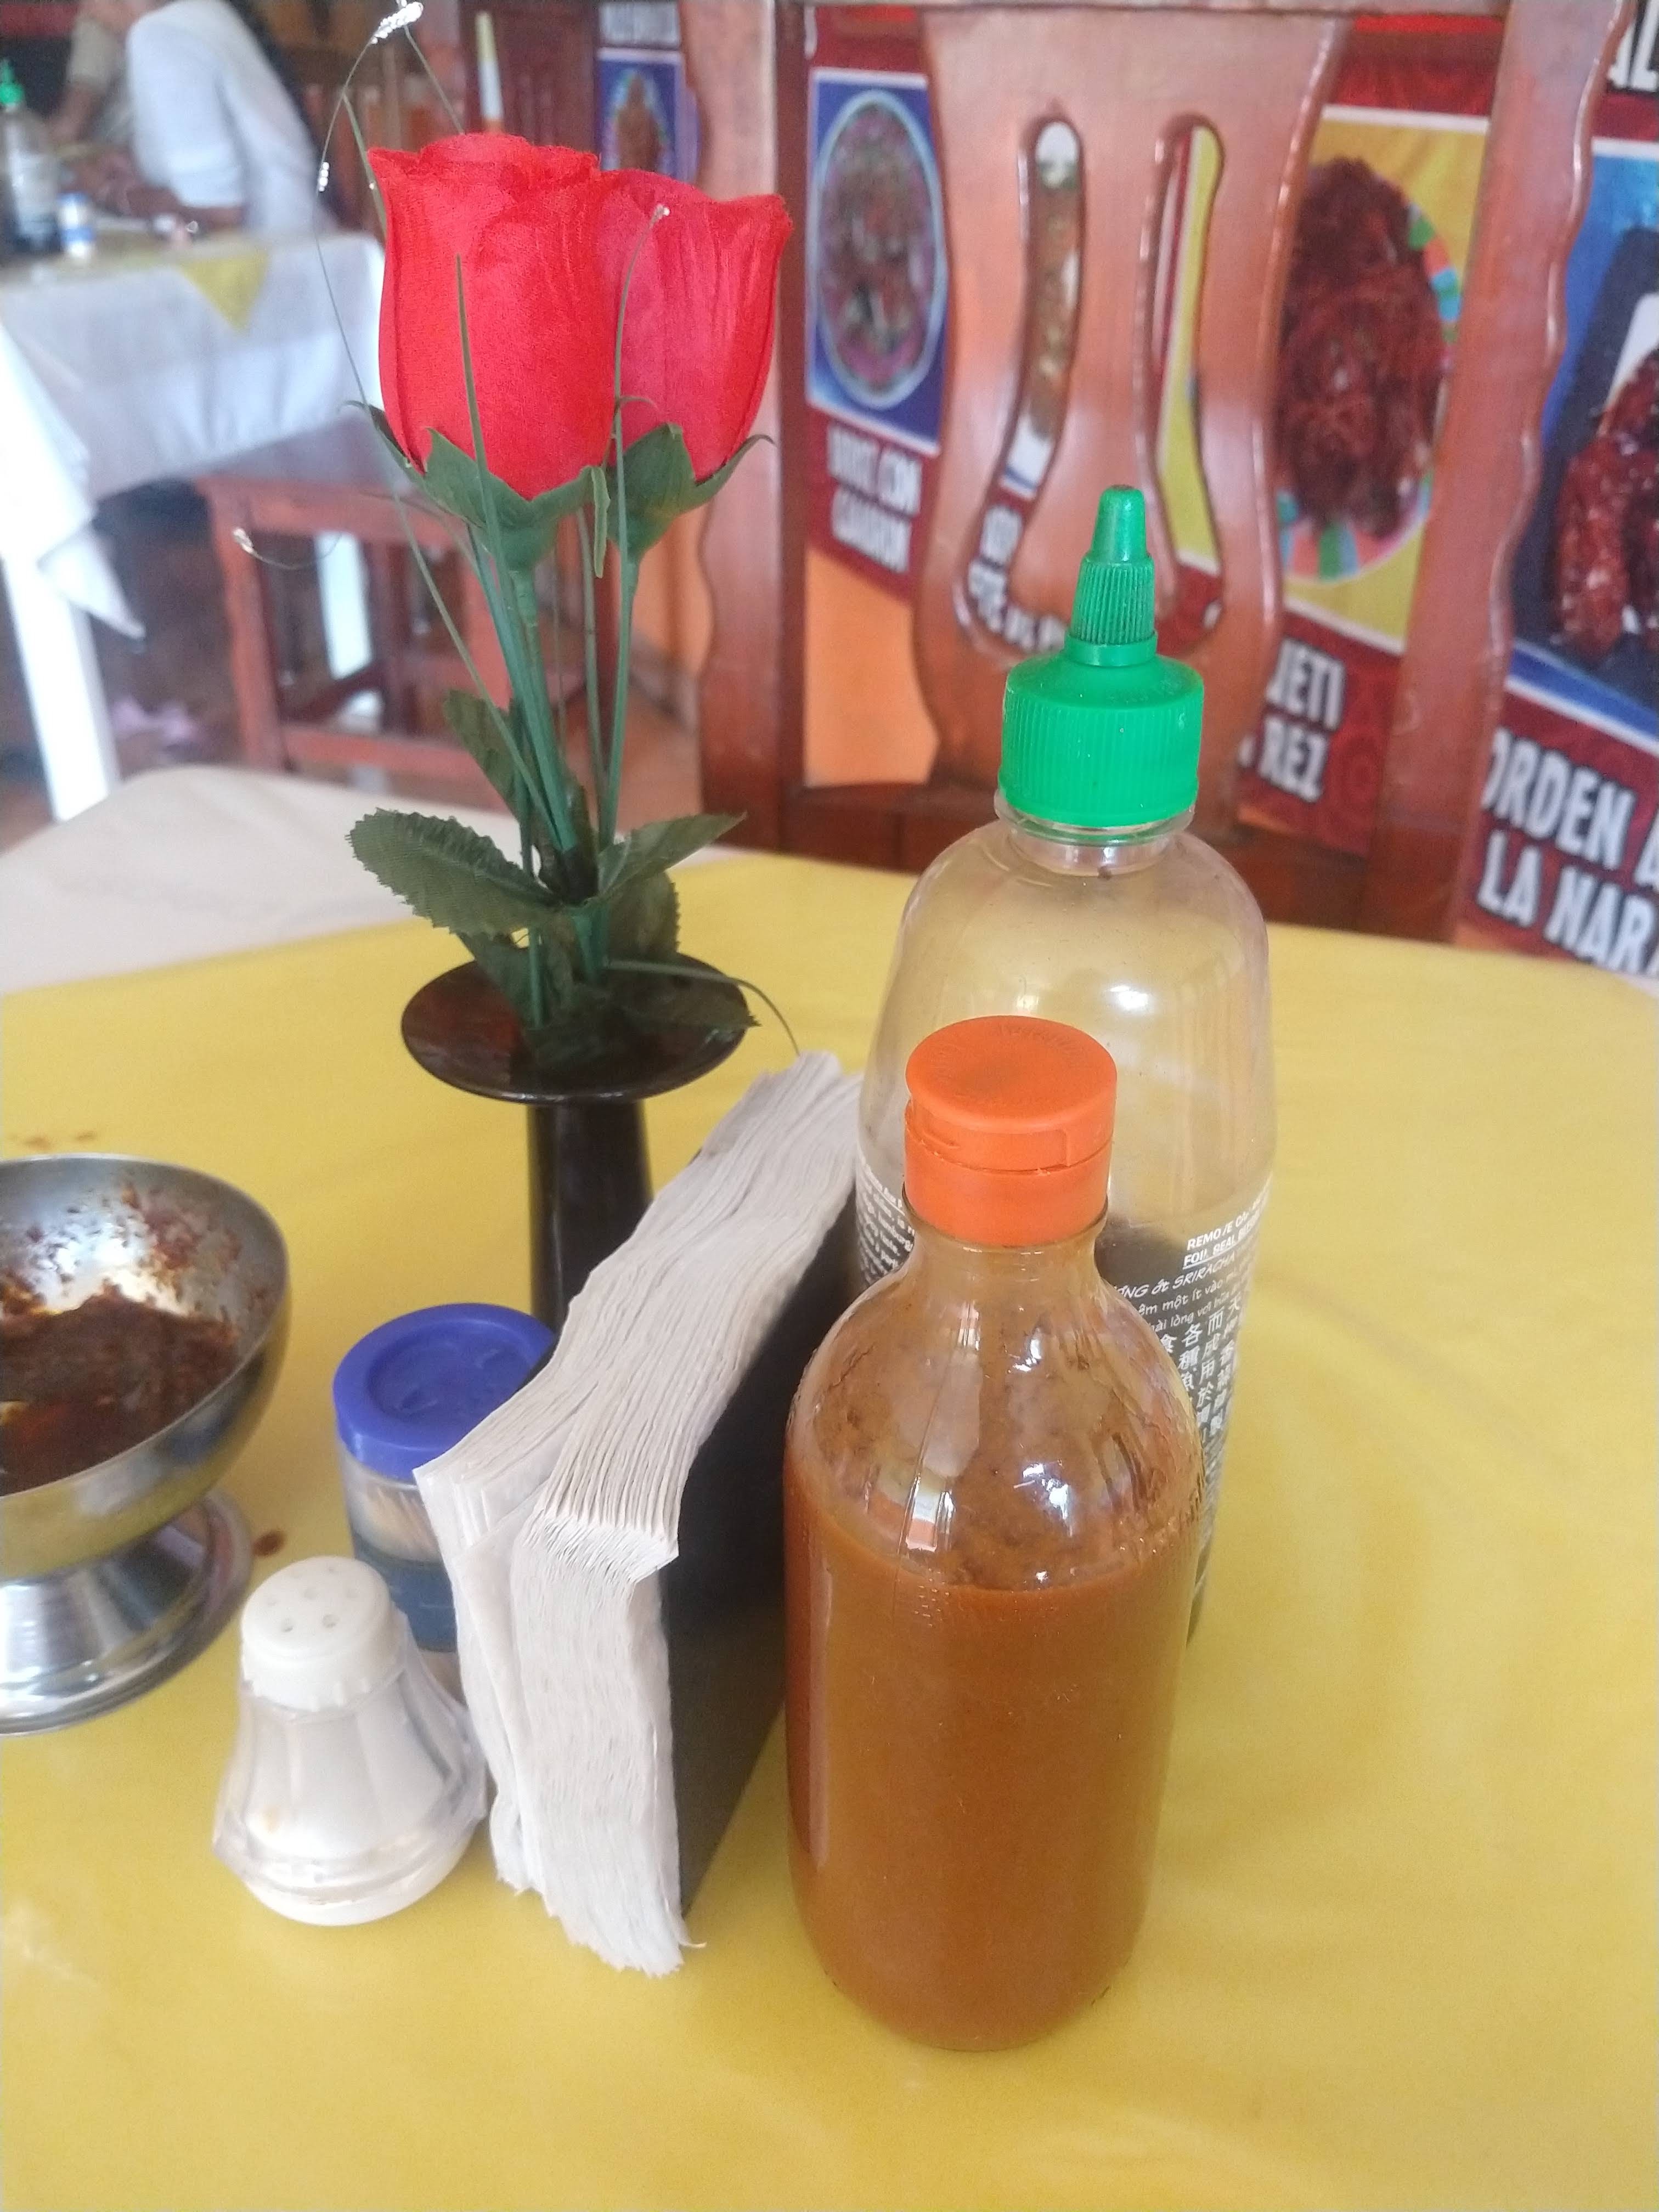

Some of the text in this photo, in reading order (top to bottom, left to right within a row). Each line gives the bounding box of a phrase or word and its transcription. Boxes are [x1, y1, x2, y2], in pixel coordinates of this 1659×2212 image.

[1477, 831, 1659, 979] LA NAR
[1172, 1250, 1235, 1289] SRIRACHA
